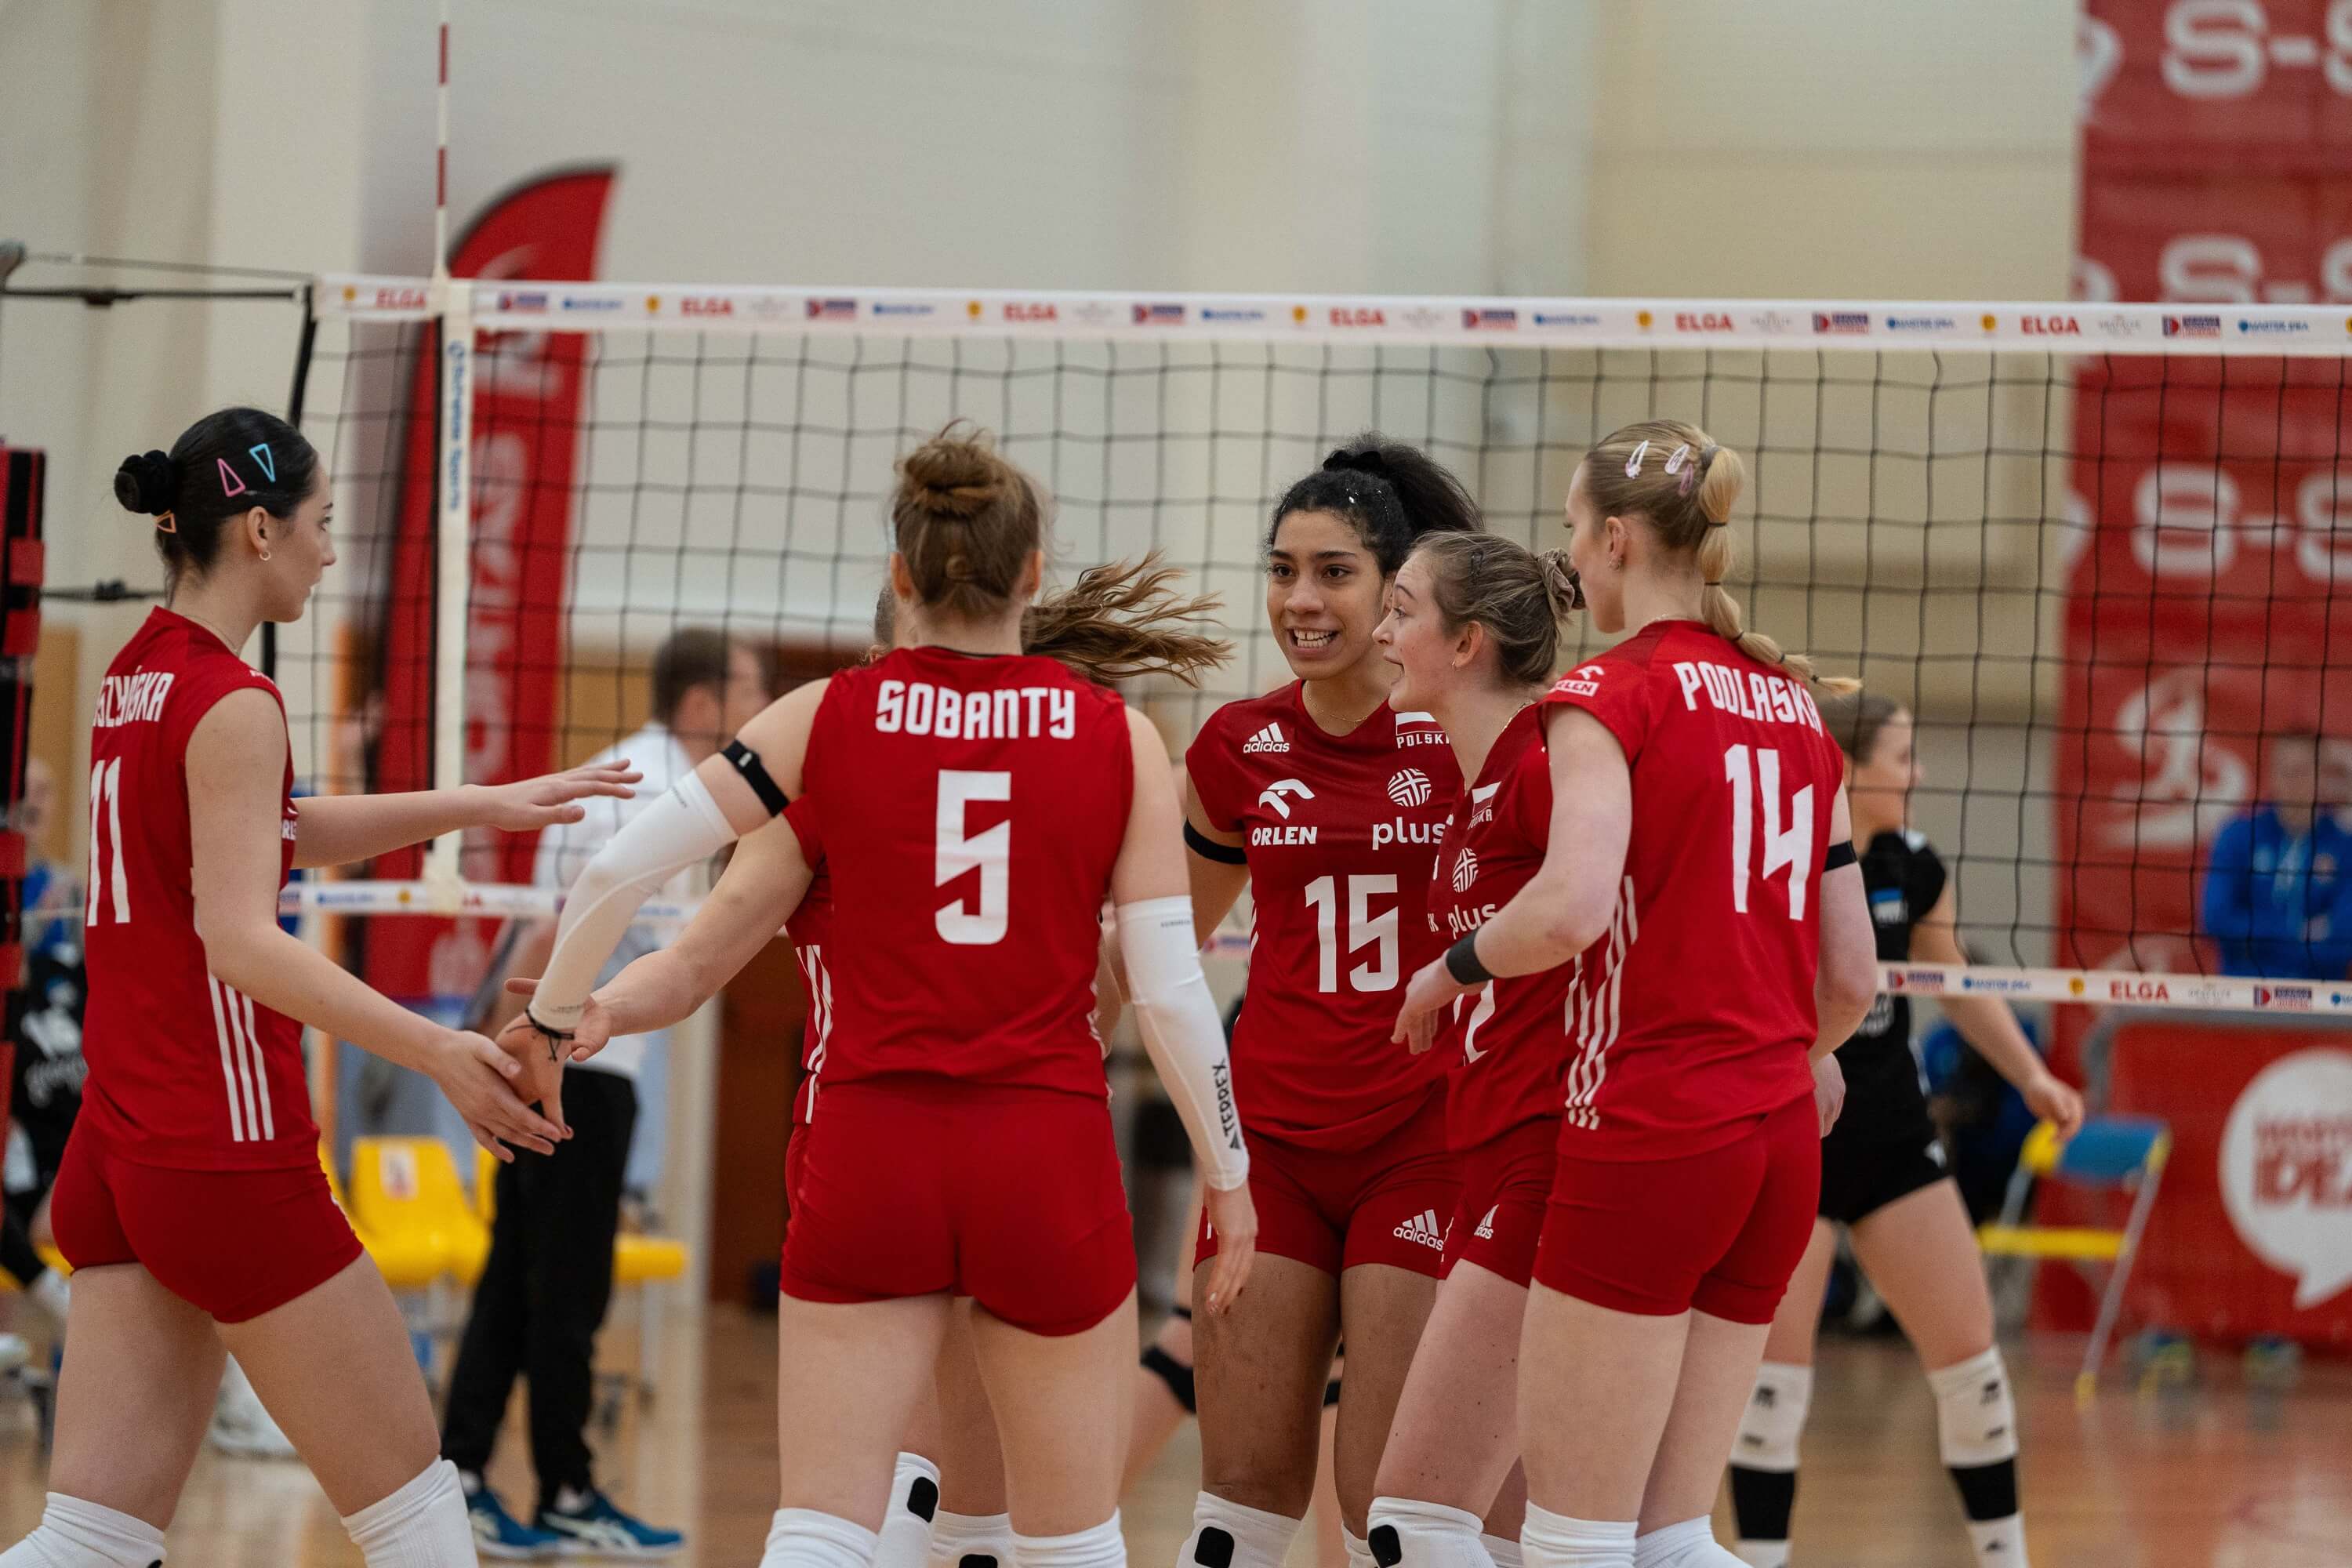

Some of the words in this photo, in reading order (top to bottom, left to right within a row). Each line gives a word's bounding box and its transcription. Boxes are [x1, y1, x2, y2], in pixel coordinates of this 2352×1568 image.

[681, 298, 734, 318] ELGA
[1004, 303, 1058, 323] ELGA
[1330, 307, 1385, 327] ELGA
[1675, 313, 1734, 332] ELGA
[2021, 315, 2081, 336] ELGA
[875, 679, 1076, 740] SOBANTY
[1672, 661, 1823, 739] PODLASKA
[1243, 740, 1290, 753] adidas
[87, 755, 131, 927] 11
[1251, 826, 1318, 847] ORLEN
[1372, 816, 1446, 851] plus
[1724, 743, 1814, 921] 14
[935, 769, 1011, 945] 5
[1305, 873, 1399, 993] 15
[2107, 980, 2169, 1002] ELGA
[1393, 1226, 1444, 1252] adidas
